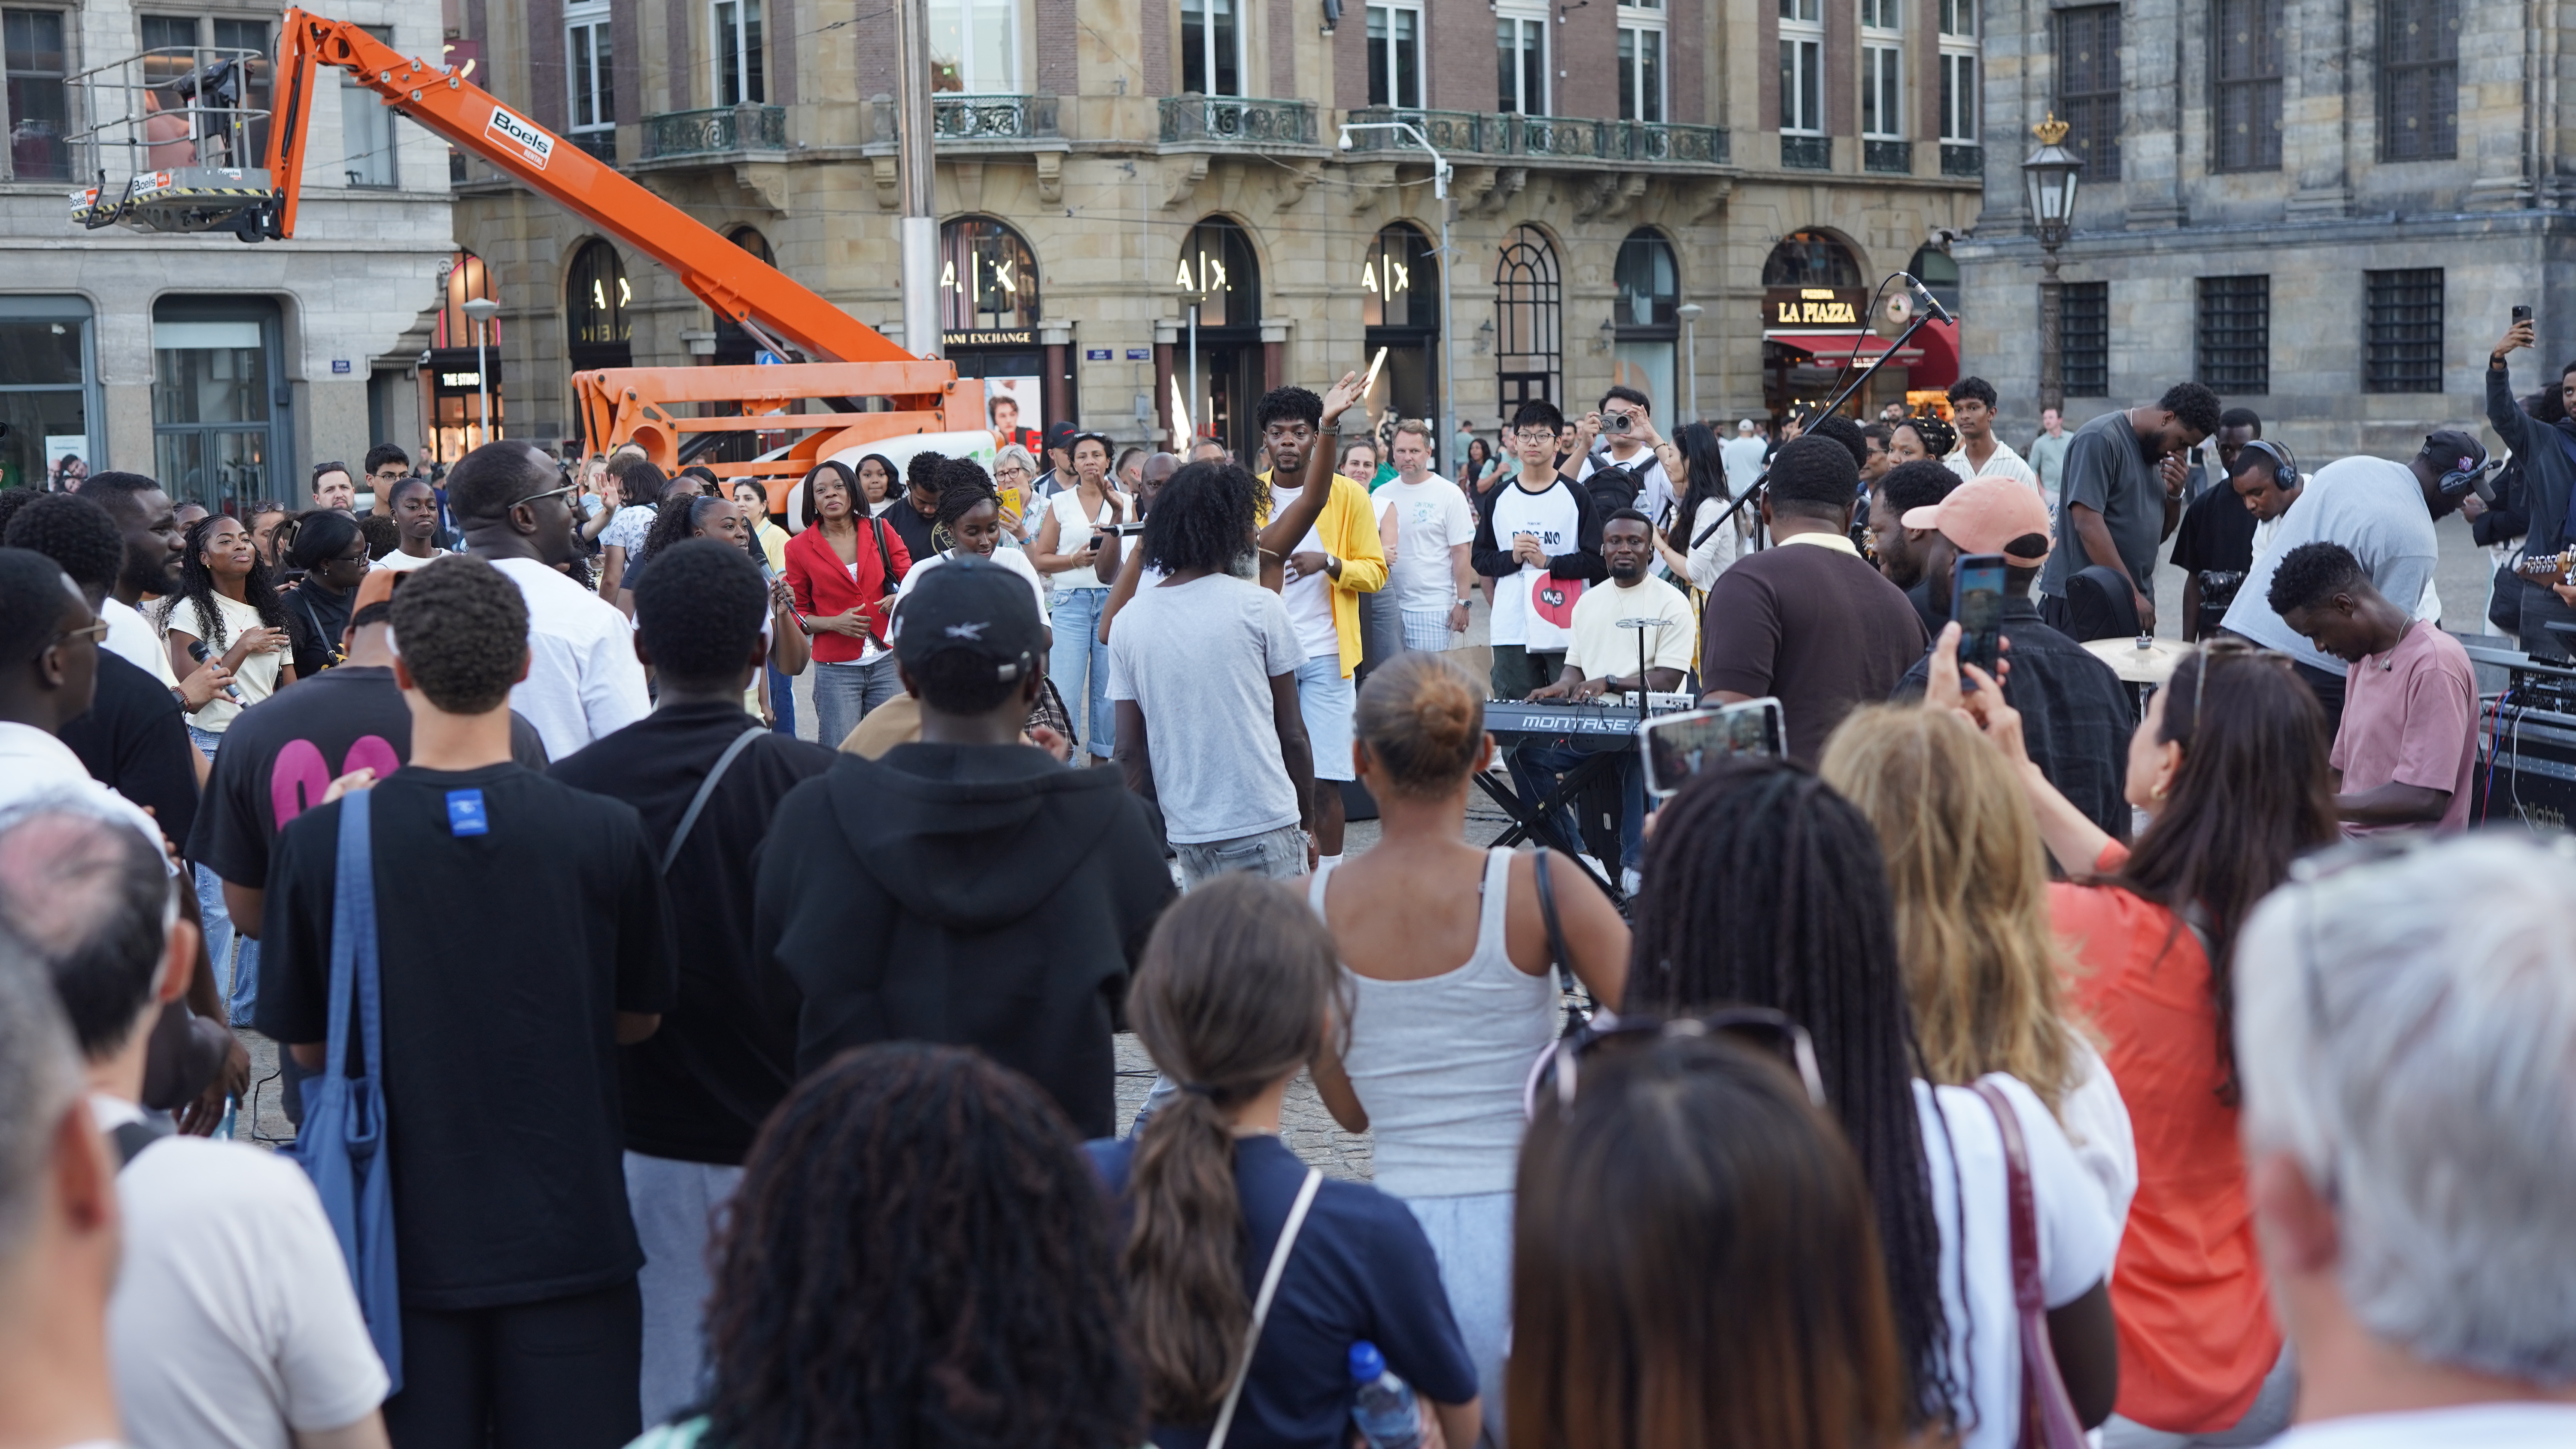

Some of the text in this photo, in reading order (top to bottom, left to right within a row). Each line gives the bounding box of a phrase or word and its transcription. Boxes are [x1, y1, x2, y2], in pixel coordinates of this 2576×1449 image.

[493, 112, 548, 153] Boels
[523, 149, 543, 166] RENTAL
[134, 177, 155, 191] Boels
[1778, 303, 1856, 323] LA PIAZZA
[970, 332, 1031, 343] EXCHANGE
[443, 373, 480, 386] THE STING
[1522, 716, 1629, 731] MONTAGE
